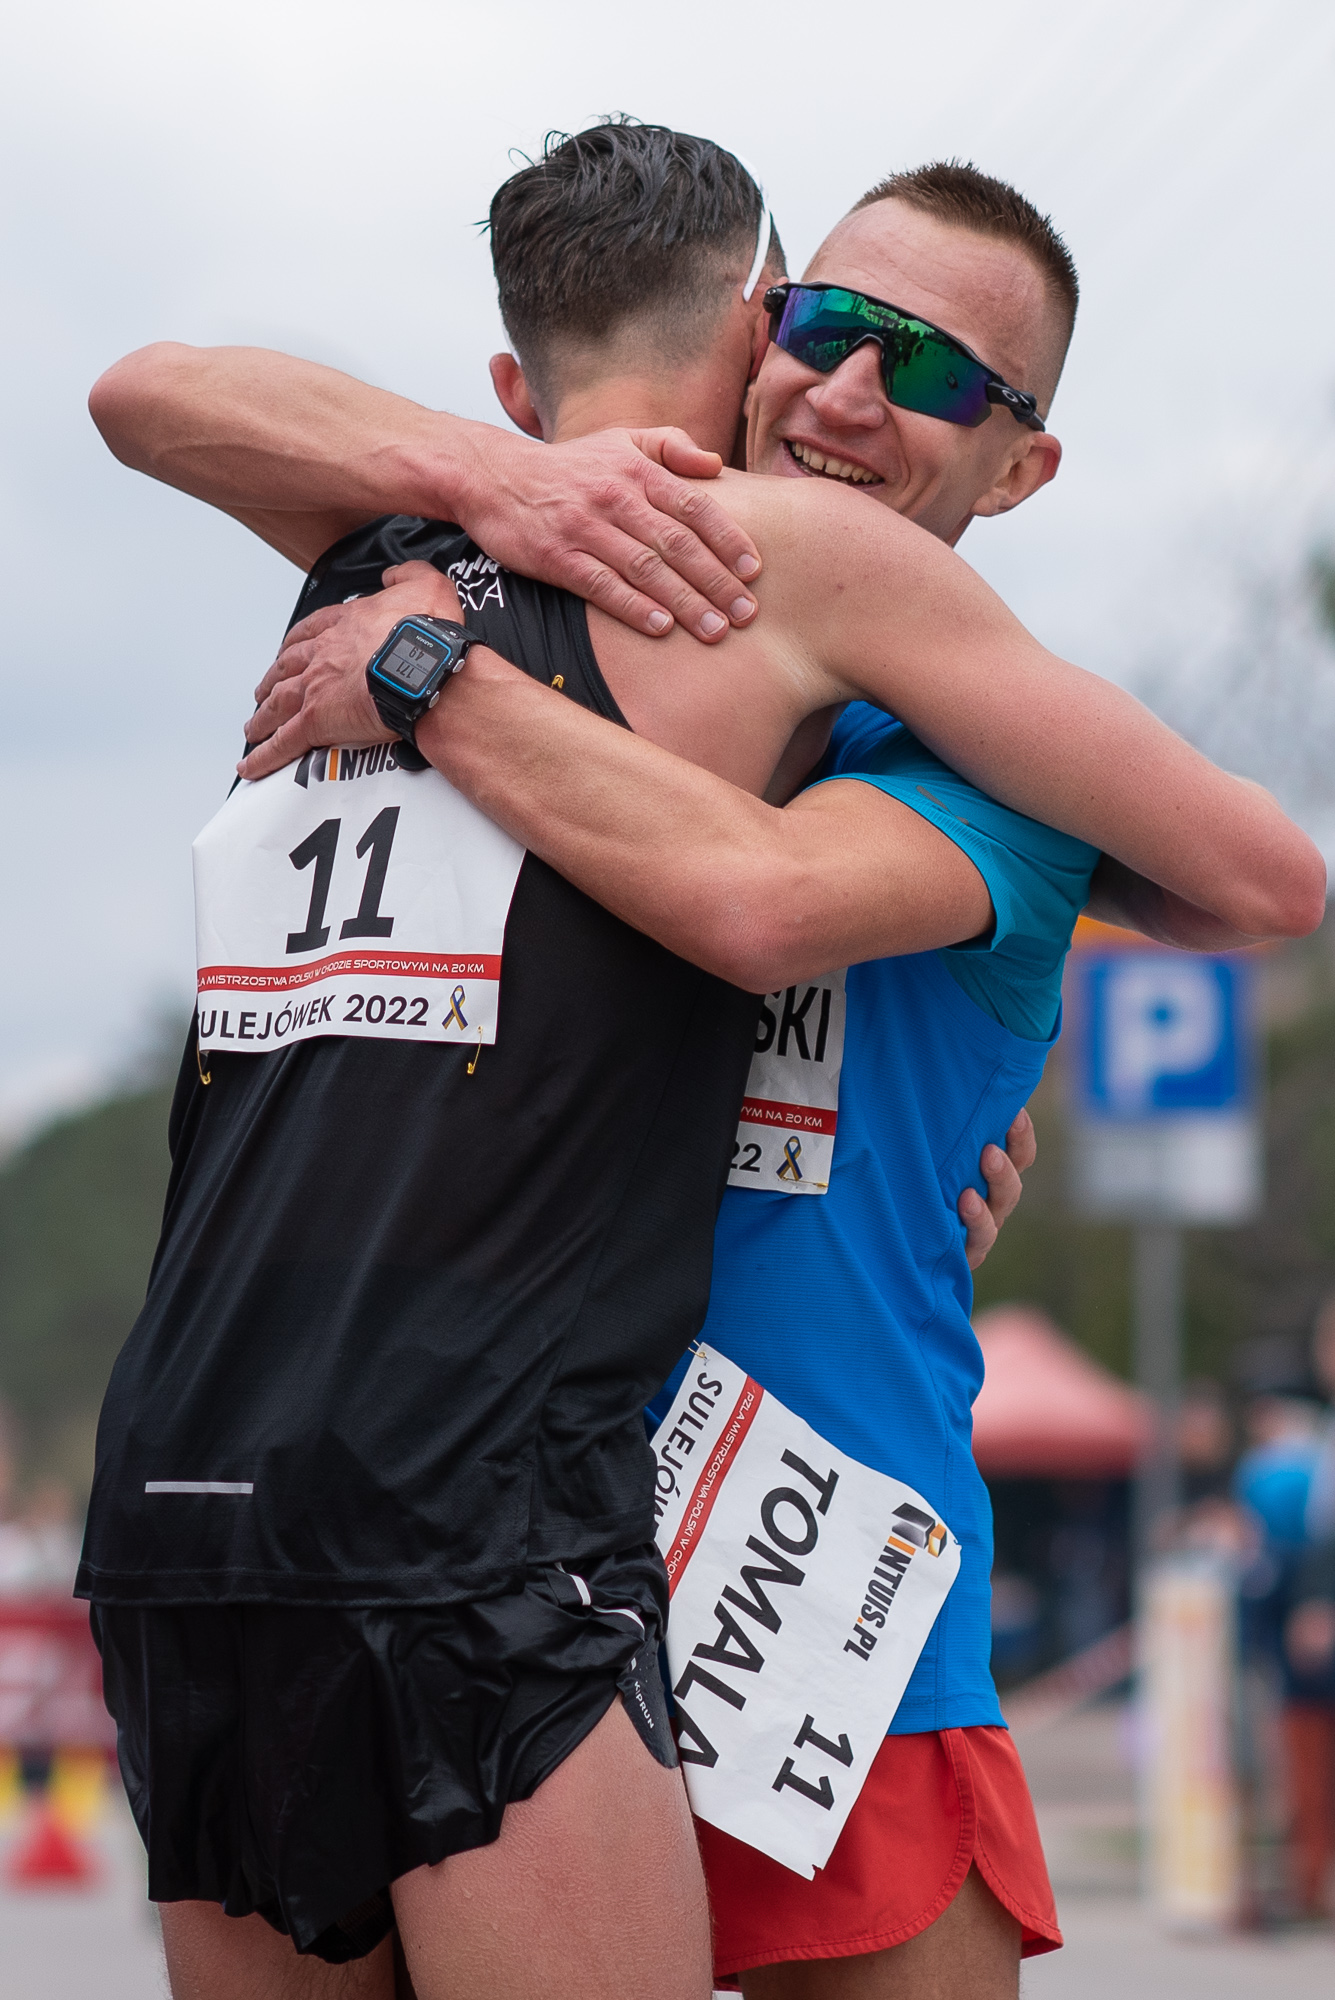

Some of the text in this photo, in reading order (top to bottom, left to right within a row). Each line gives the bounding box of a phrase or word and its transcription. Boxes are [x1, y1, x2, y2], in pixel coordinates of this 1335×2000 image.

[395, 661, 415, 679] 171
[408, 646, 425, 661] 49
[328, 742, 401, 781] INTUIS
[285, 806, 401, 954] 11
[206, 974, 288, 987] MISTRZOSTWA
[288, 970, 315, 985] POLSKI
[321, 959, 353, 975] CHODZIE
[353, 959, 429, 972] SPORTOWYM
[431, 962, 449, 973] NA
[451, 963, 466, 974] 20
[467, 963, 485, 974] KM
[200, 993, 430, 1040] ULEJÓWEK 2022
[1103, 956, 1223, 1104] P
[765, 1109, 783, 1122] NA
[785, 1112, 803, 1125] 20
[804, 1115, 823, 1128] KM
[736, 1391, 755, 1421] PZLA
[697, 1420, 741, 1499] MISTRZOSTWA
[683, 1499, 705, 1538] POLSKI
[679, 1537, 690, 1551] W
[673, 1448, 840, 1769] TOMALA
[843, 1535, 917, 1662] INTUIS.PL
[634, 1680, 655, 1729] KIPRUN
[771, 1713, 854, 1811] 11
